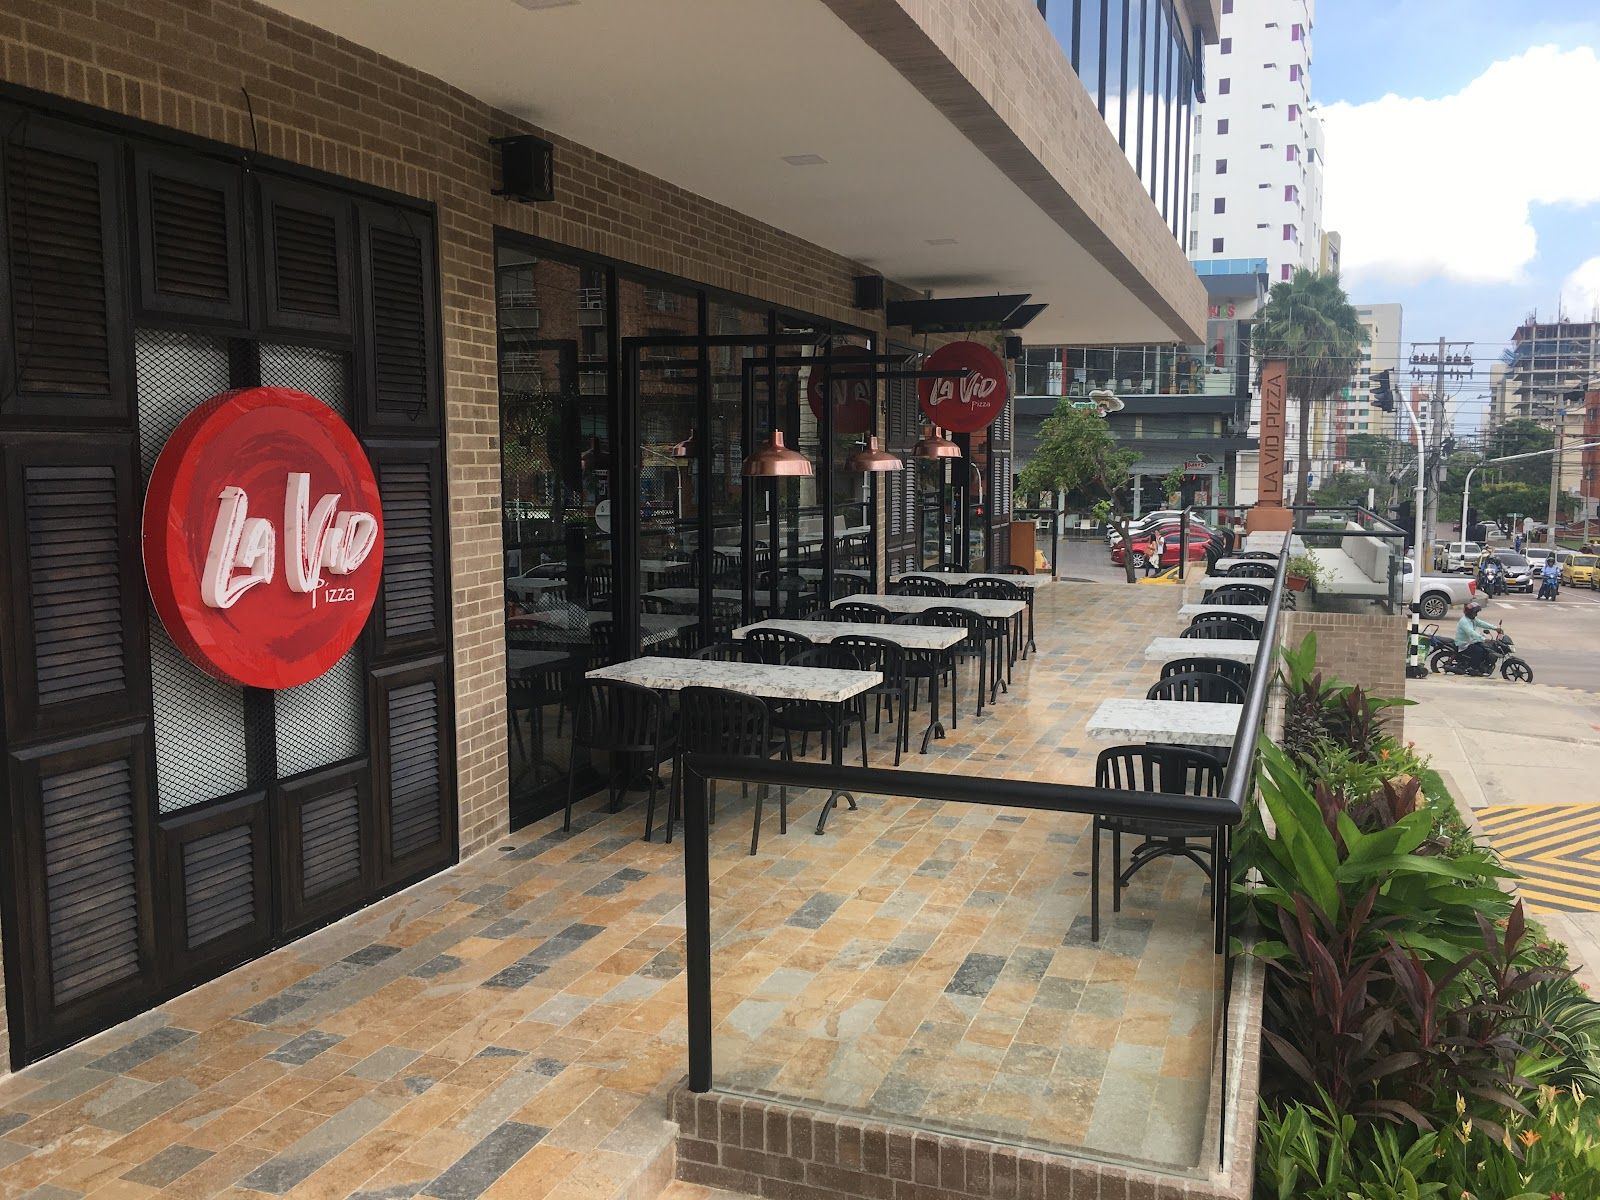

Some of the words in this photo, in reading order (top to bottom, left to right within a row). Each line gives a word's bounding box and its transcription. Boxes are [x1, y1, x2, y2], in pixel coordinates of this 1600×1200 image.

[1266, 374, 1282, 428] PIZZA
[1264, 435, 1279, 465] VID
[1263, 471, 1278, 493] LA
